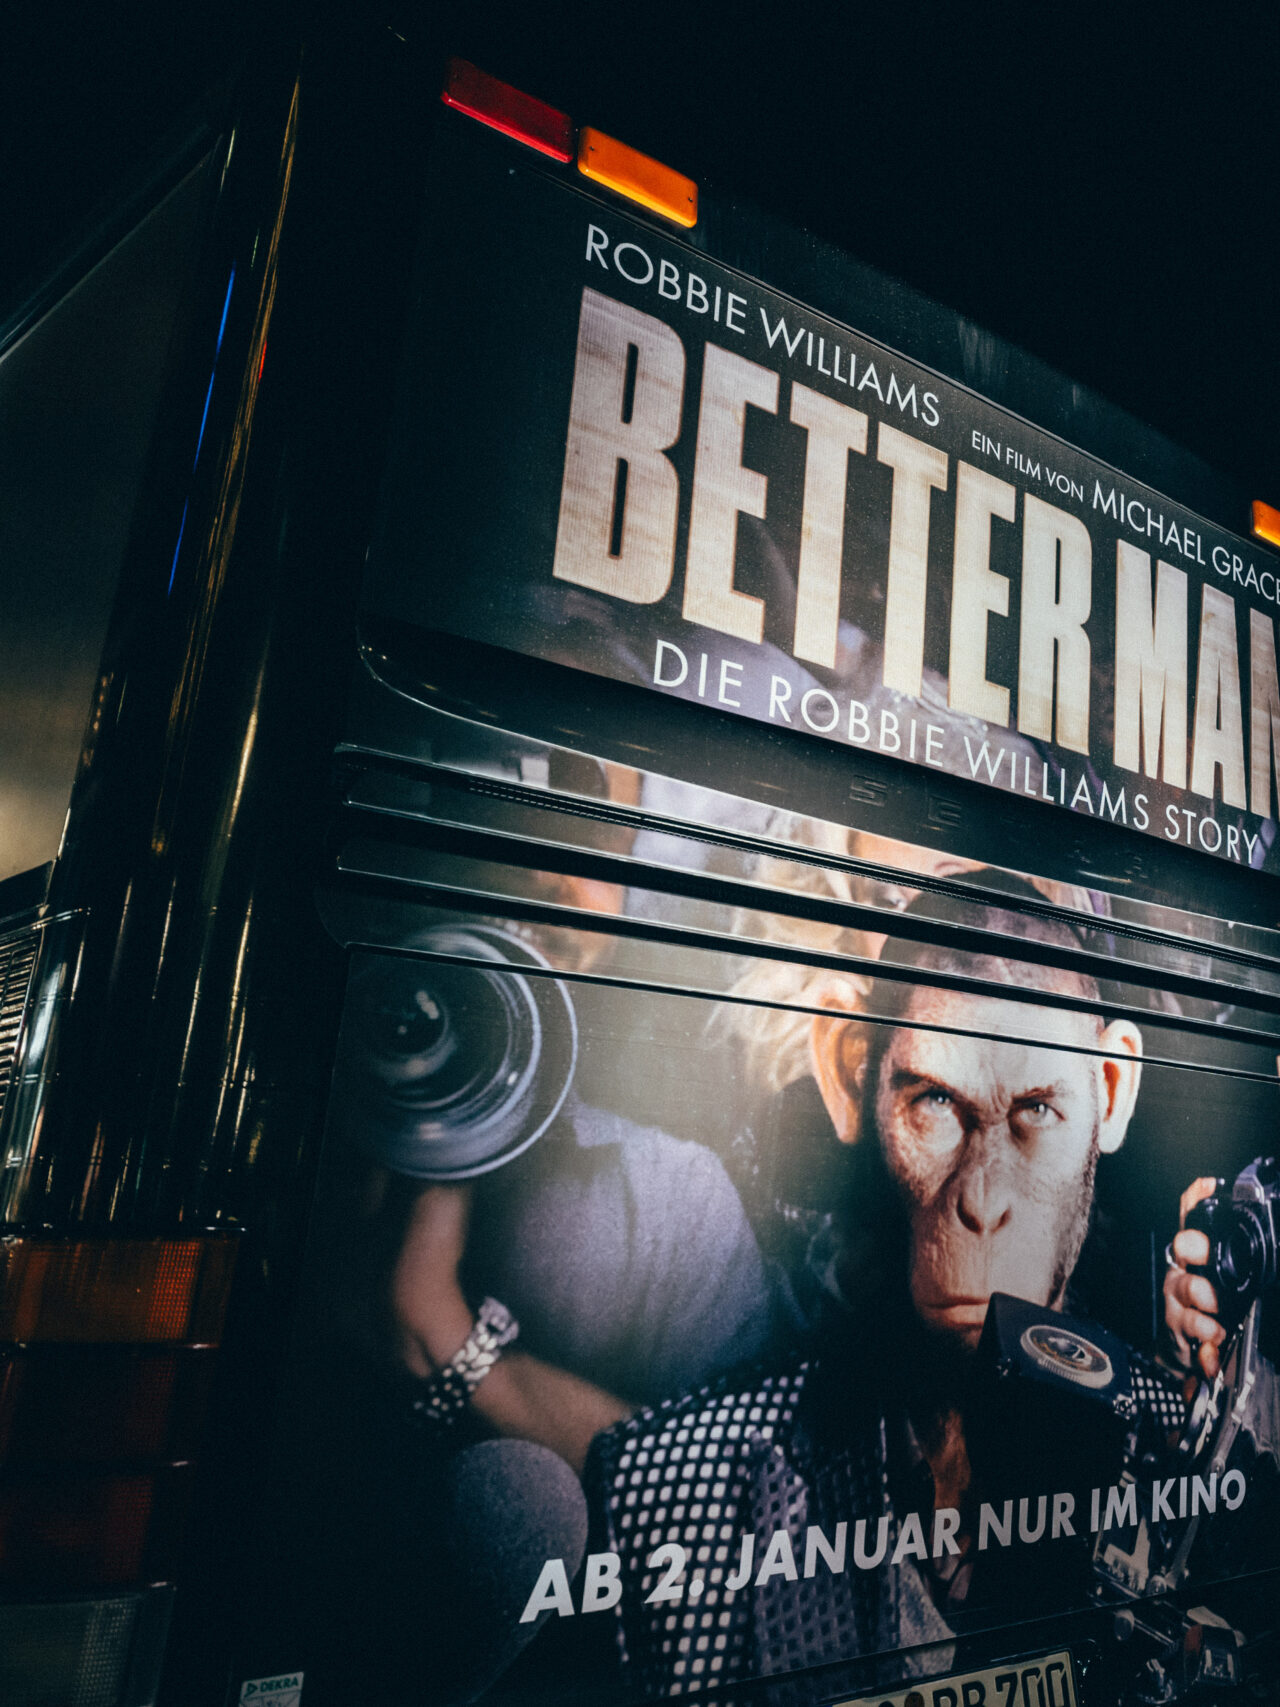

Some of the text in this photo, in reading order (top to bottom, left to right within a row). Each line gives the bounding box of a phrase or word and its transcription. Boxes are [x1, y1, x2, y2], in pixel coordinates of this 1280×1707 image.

[584, 223, 941, 427] ROBBIE WILLIAMS
[553, 285, 1092, 756] BETTER
[971, 430, 1001, 459] EIN
[1005, 447, 1042, 482] FILM
[1045, 465, 1084, 503] VON
[1092, 479, 1206, 566] MICHAEL
[653, 639, 745, 707] DIE
[769, 674, 944, 769] ROBBIE
[963, 735, 1149, 831] WILLIAMS
[1165, 804, 1259, 866] STORY
[518, 1469, 1247, 1625] AB 2. JANUAR NUR IM KINO
[260, 1676, 298, 1692] DEKRA
